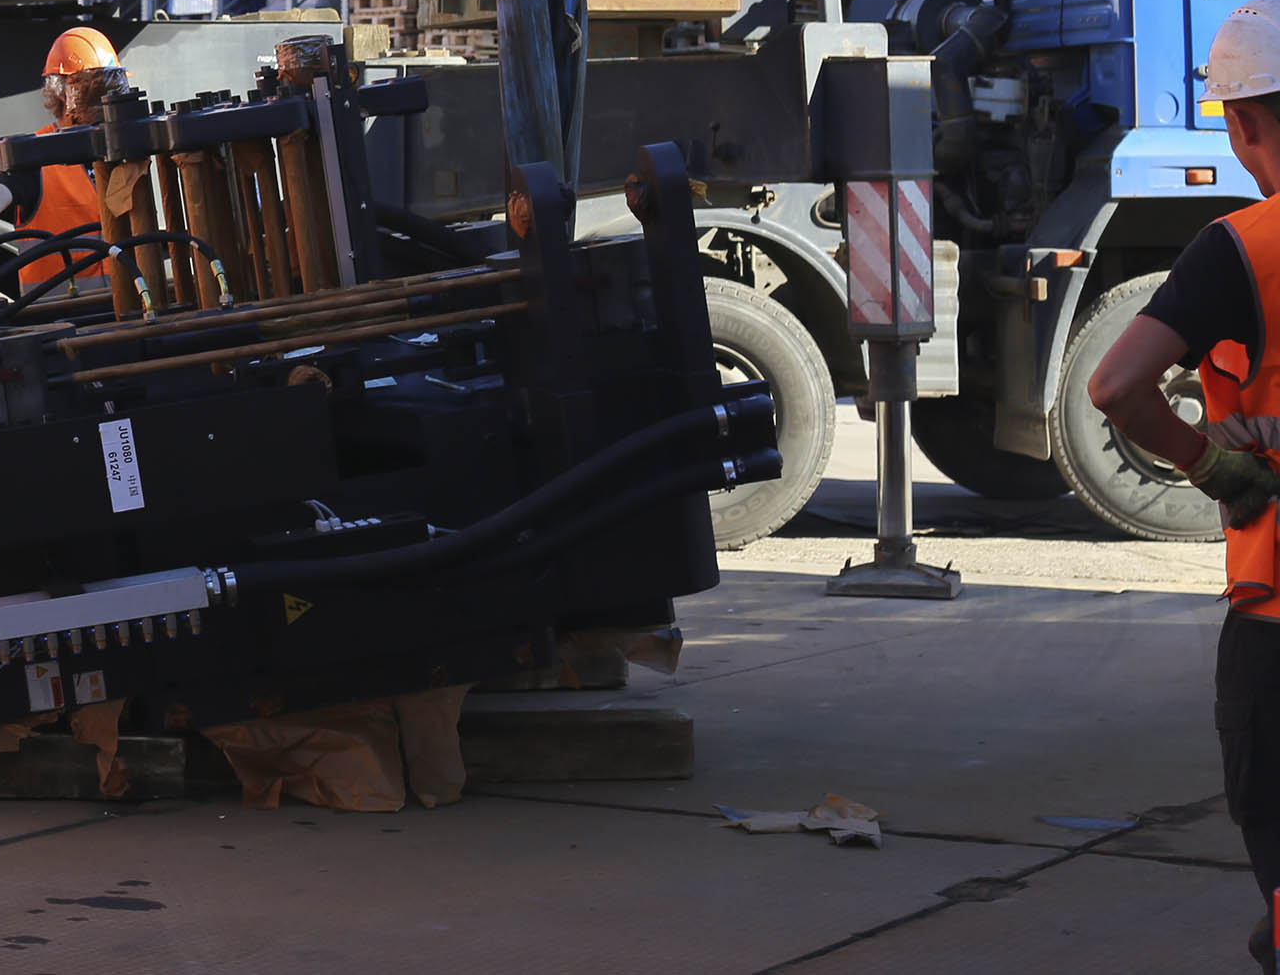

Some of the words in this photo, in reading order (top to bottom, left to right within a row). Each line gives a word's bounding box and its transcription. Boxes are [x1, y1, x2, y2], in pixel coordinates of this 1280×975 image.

[108, 451, 121, 481] 61247
[119, 426, 133, 463] JU1080
[127, 475, 139, 497] 中国
